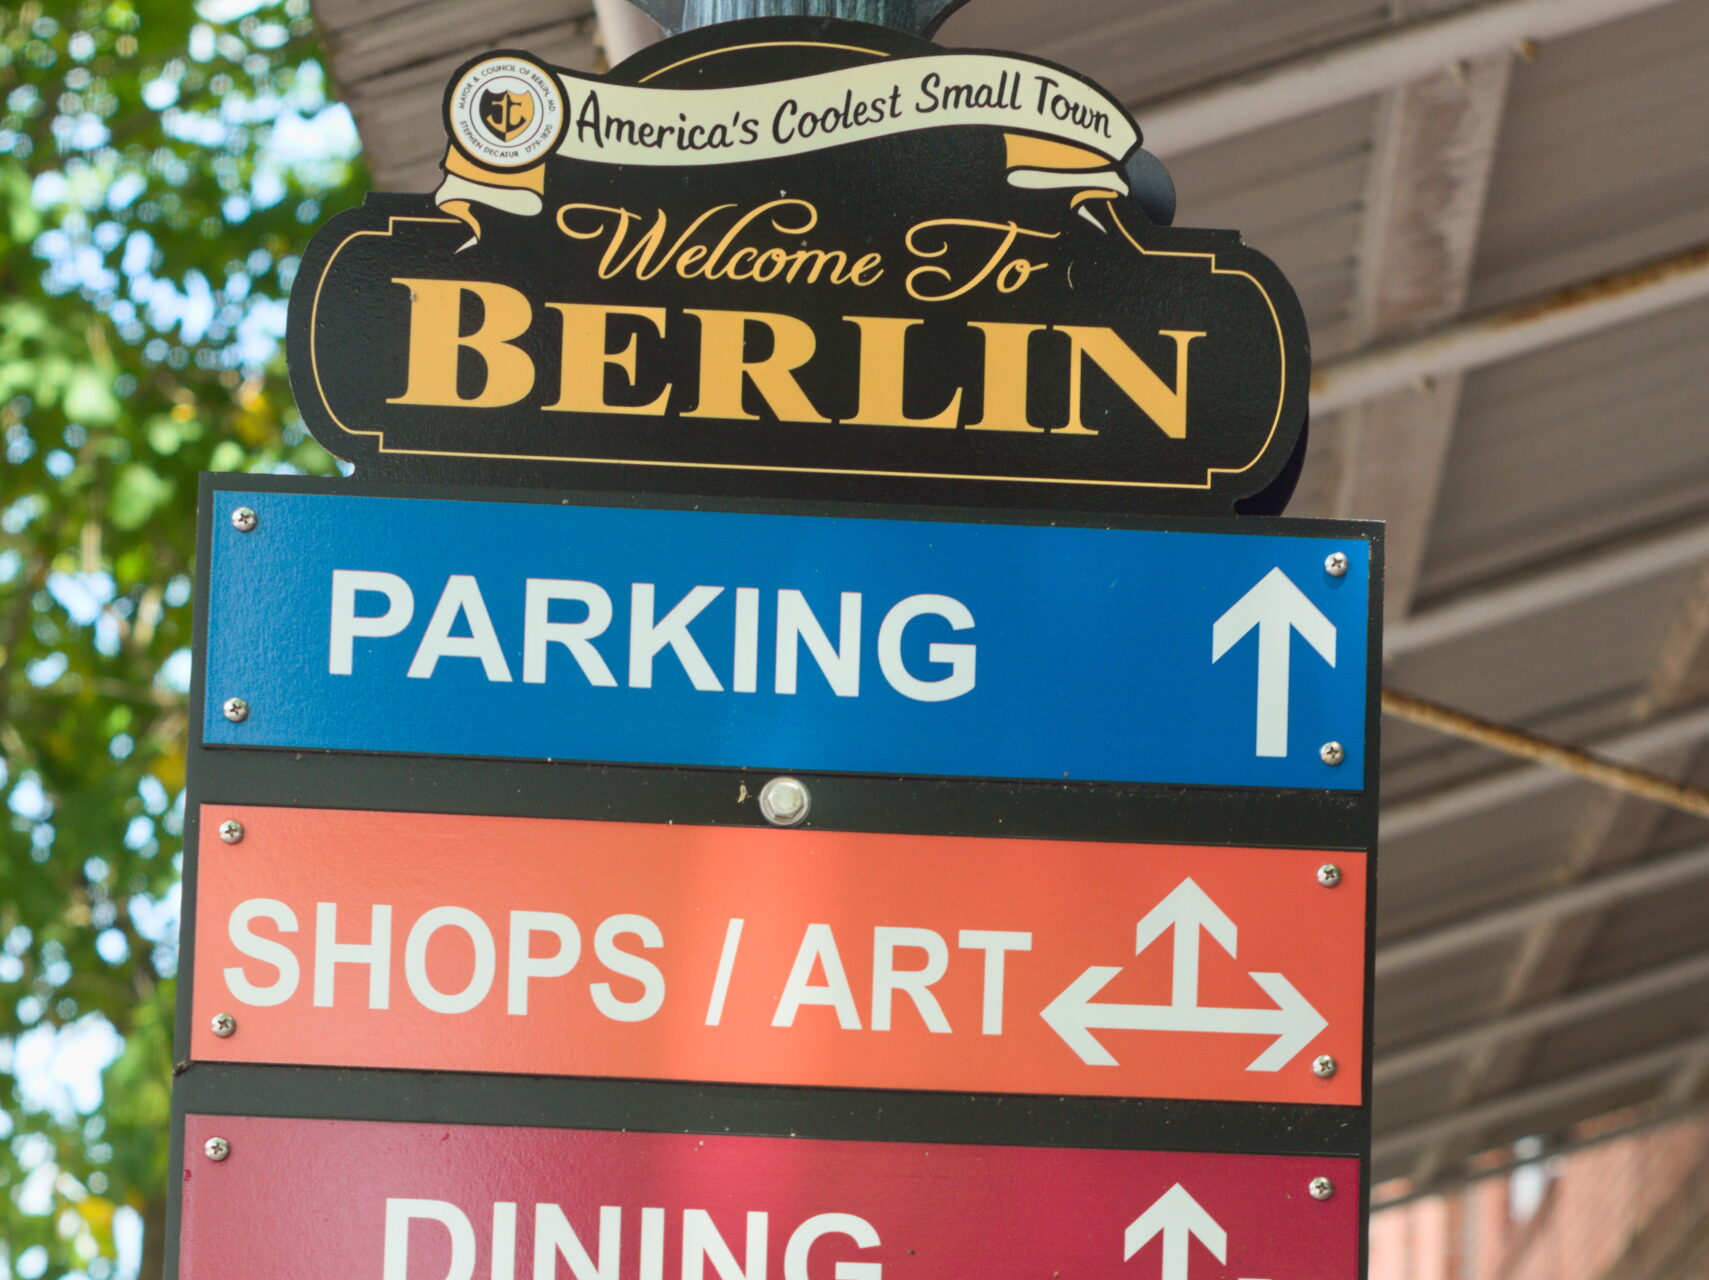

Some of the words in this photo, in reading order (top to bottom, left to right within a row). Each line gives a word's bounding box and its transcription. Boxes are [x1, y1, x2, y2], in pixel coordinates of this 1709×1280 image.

[459, 82, 473, 109] MAYOR
[481, 64, 516, 77] COUNCIL
[519, 67, 531, 76] OF
[576, 89, 759, 151] America's
[772, 84, 902, 144] Coolest
[915, 70, 1022, 113] Small
[1034, 75, 1112, 139] Town
[460, 120, 483, 149] STEPHEN
[483, 146, 519, 158] DECATUR
[556, 198, 884, 287] Welcome
[905, 217, 1061, 302] To
[386, 277, 1208, 440] BERLIN
[329, 569, 980, 702] PARKING
[222, 897, 667, 1024] SHOPS
[704, 917, 746, 1026] /
[770, 923, 1034, 1037] ART
